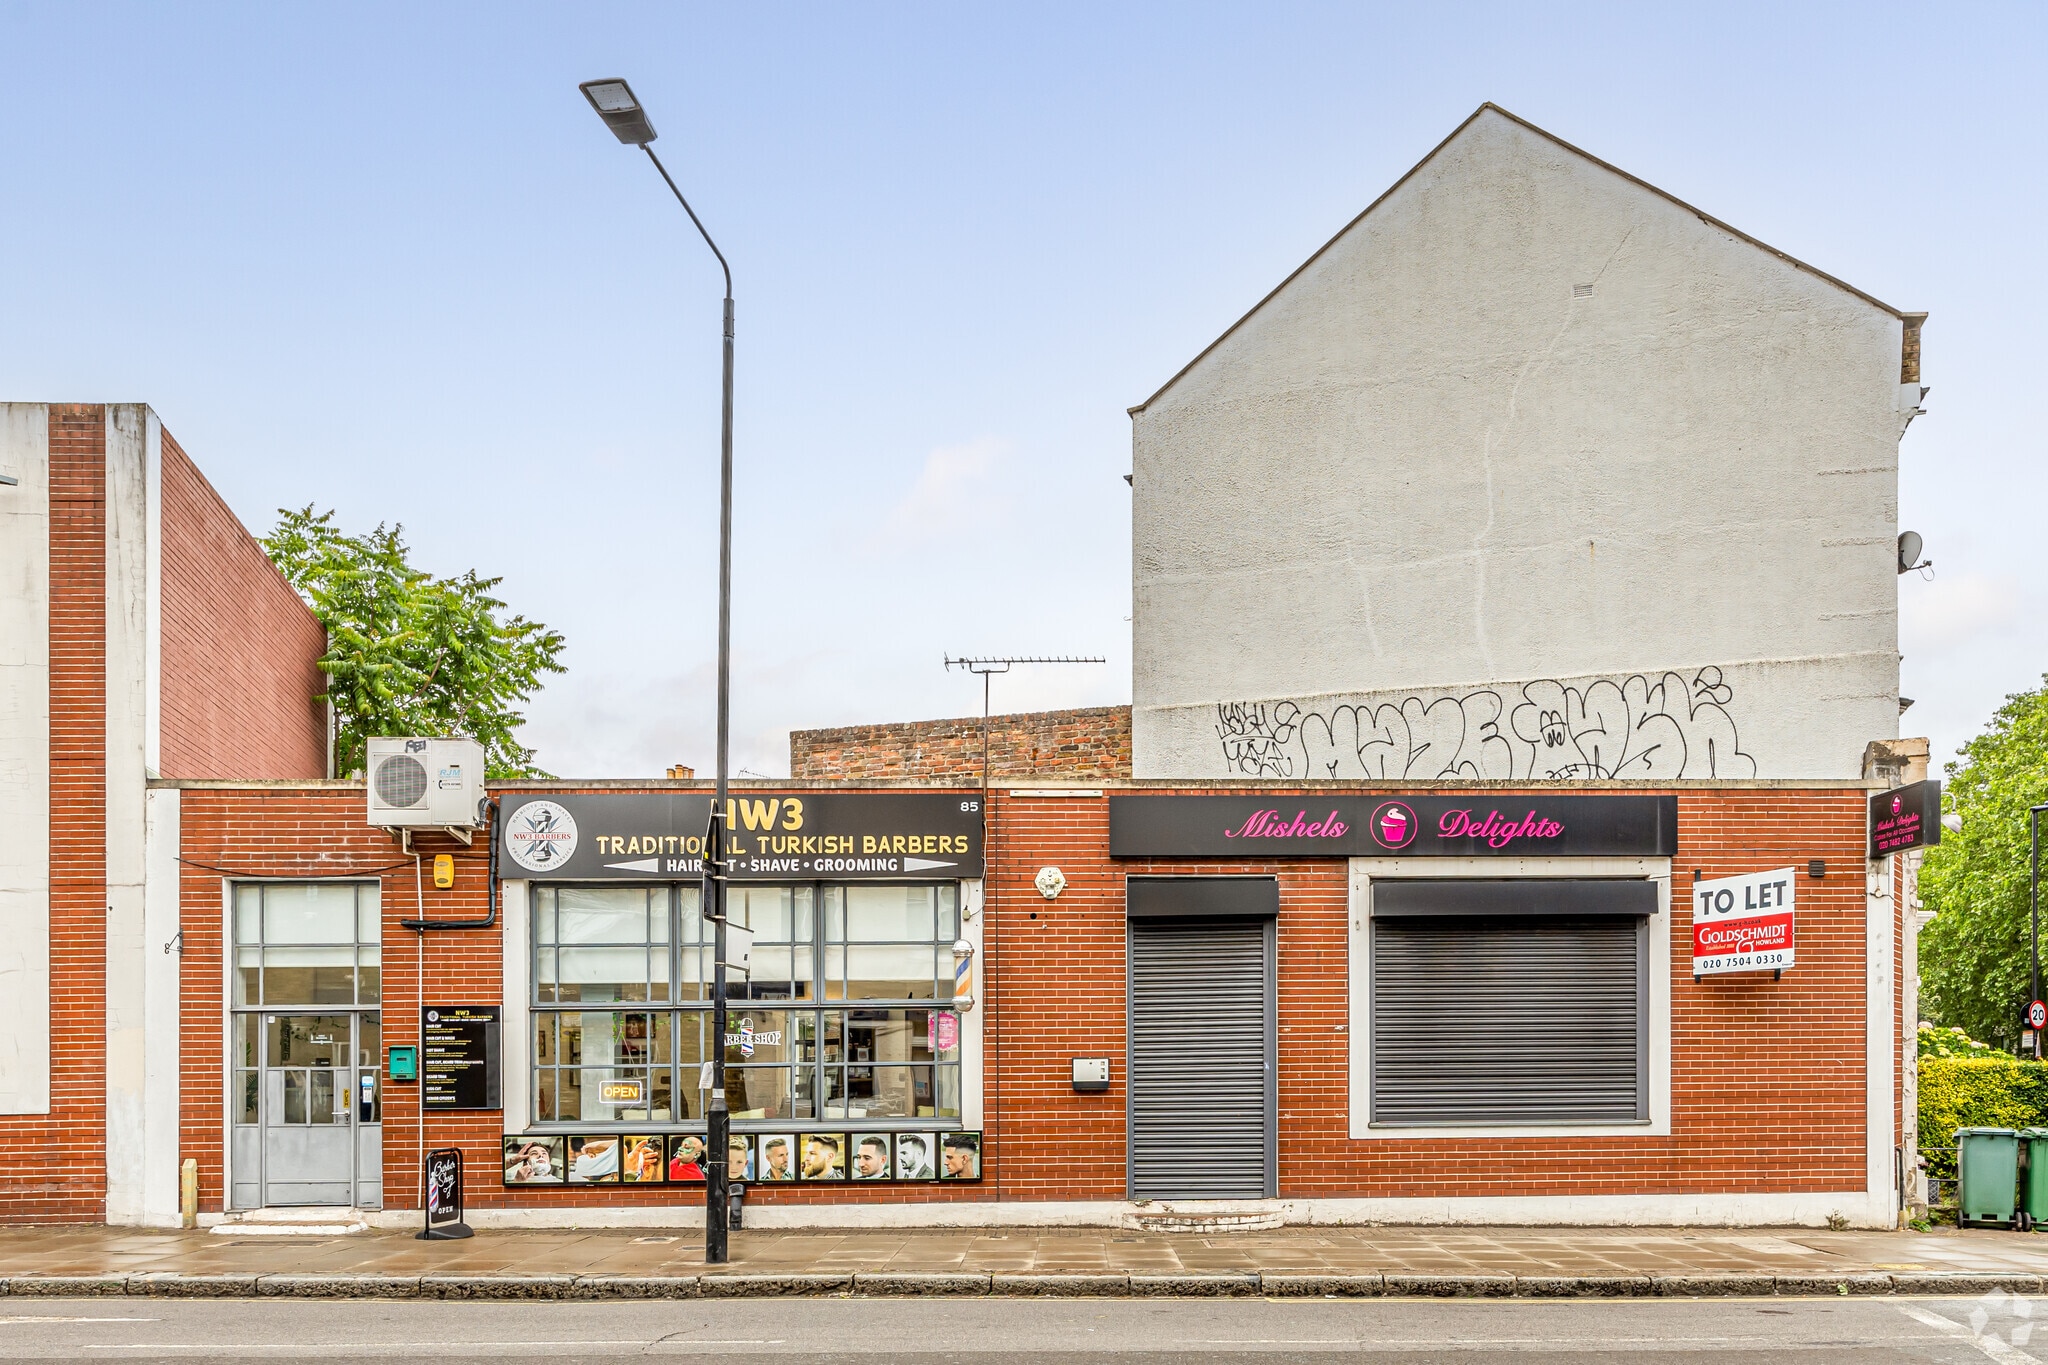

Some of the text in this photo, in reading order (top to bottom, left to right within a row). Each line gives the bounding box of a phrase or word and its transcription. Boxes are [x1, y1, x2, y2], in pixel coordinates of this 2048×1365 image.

[960, 802, 979, 812] 85
[1224, 809, 1565, 848] Mishels Delights
[596, 835, 968, 855] TRADITIOL TURKISH BARBERS
[1878, 841, 1888, 849] 020
[667, 858, 898, 872] HAIRT SHAVE GROOMING
[1699, 880, 1787, 915] TO LET
[1699, 924, 1787, 944] GOLDSCHMIDT
[1755, 938, 1785, 946] HOWLAND
[1703, 954, 1783, 969] 020 7504 0330
[2032, 1010, 2044, 1020] 20
[725, 1032, 781, 1045] RBER SHOP
[604, 1086, 638, 1097] OPEN
[434, 1159, 455, 1177] Barber
[438, 1172, 454, 1187] Shop
[438, 1205, 453, 1214] OPEN
